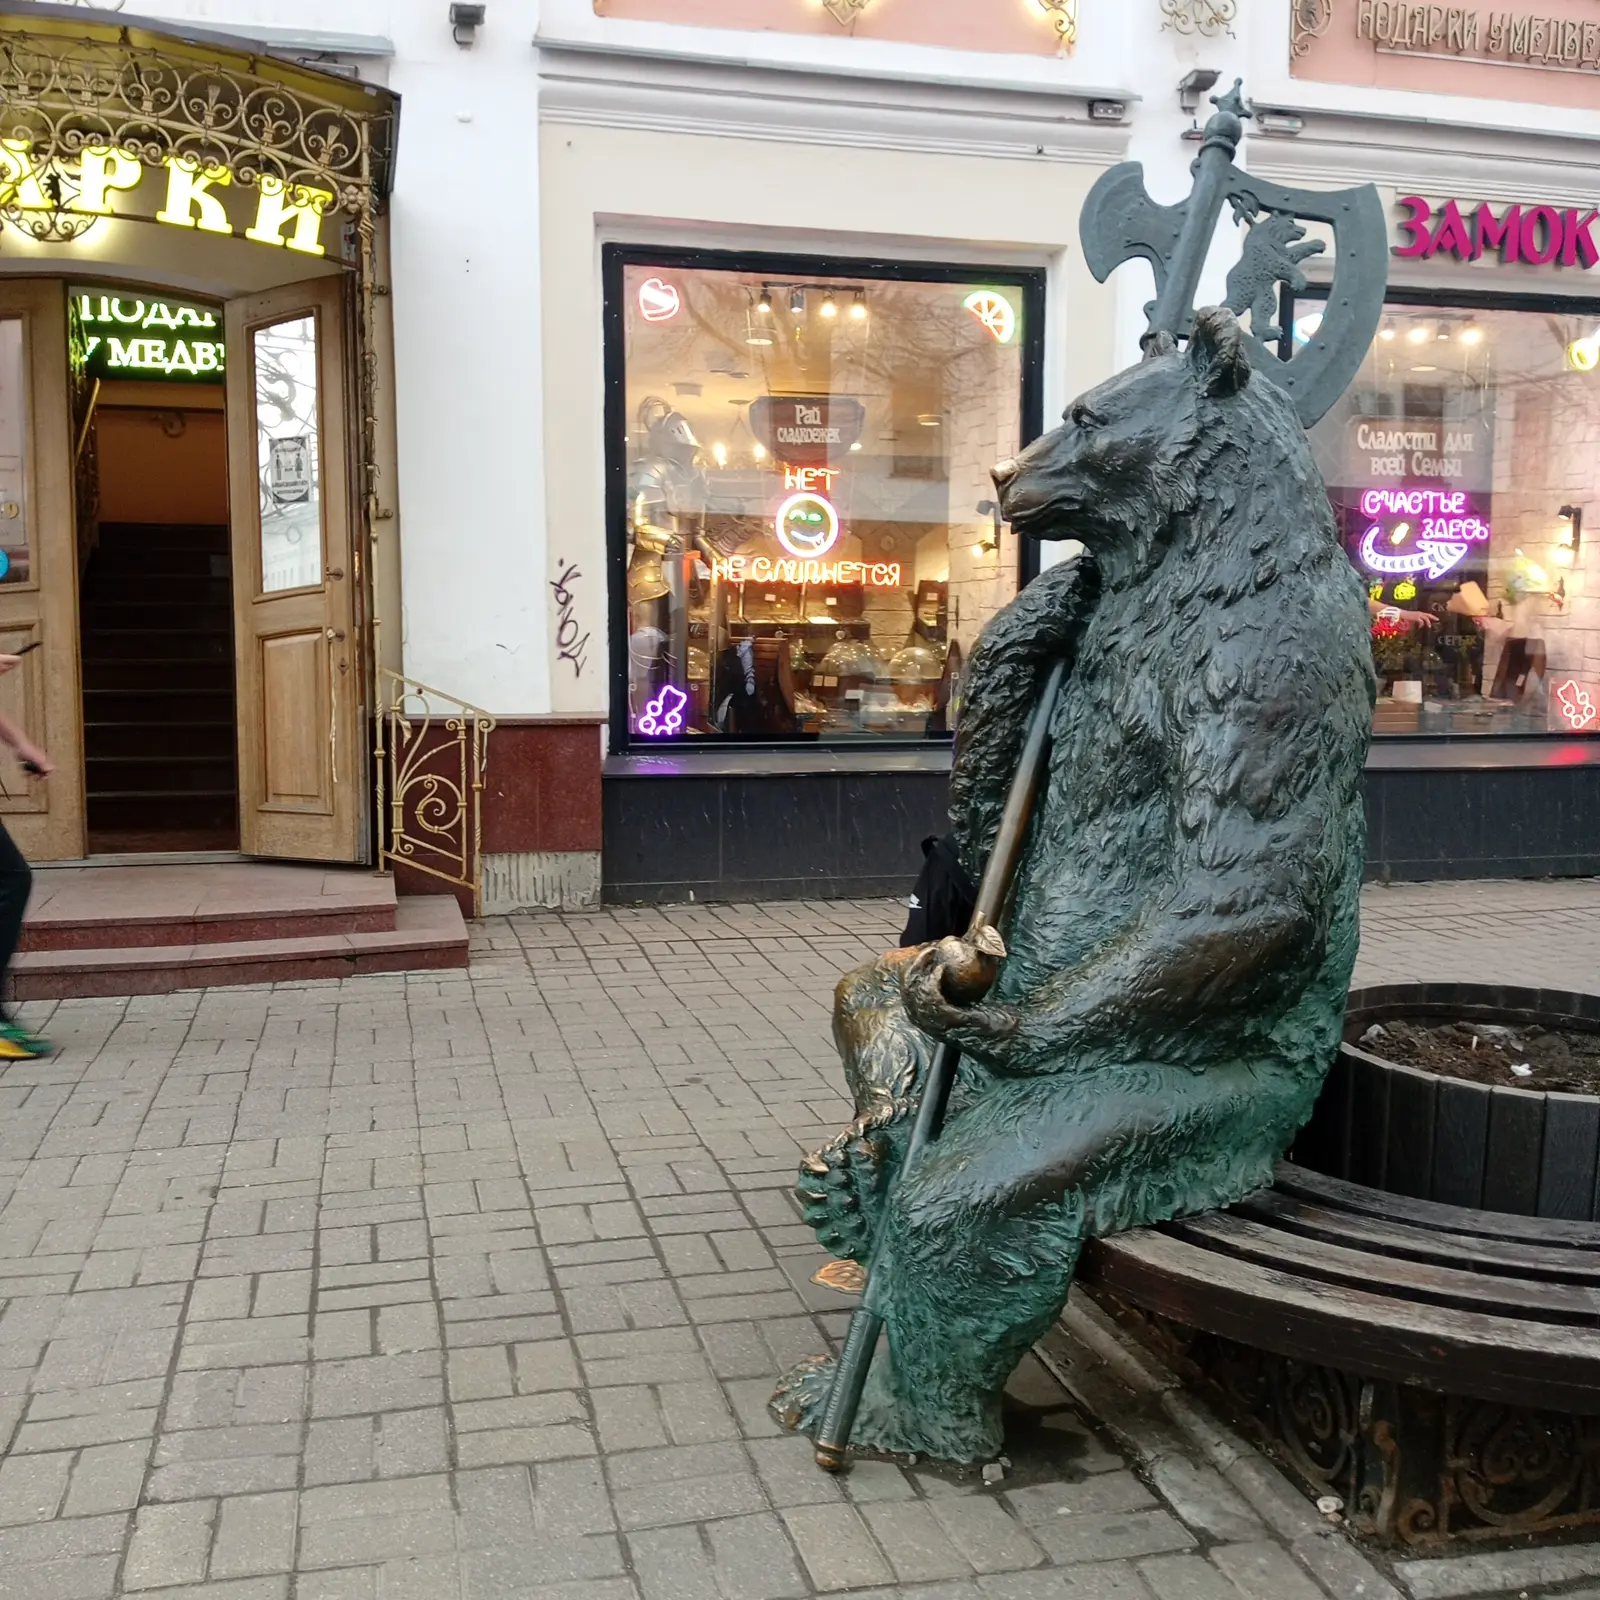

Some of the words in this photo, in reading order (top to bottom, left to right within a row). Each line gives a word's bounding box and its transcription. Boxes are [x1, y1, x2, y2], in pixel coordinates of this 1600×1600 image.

[1356, 0, 1480, 50] ПОДАРКИ
[1489, 12, 1505, 53] У
[1509, 13, 1600, 69] МЕДВЕ
[1391, 195, 1600, 269] ЗАМОК
[795, 404, 821, 425] Рай
[1357, 423, 1437, 452] Сладости
[1444, 432, 1475, 454] для
[1370, 453, 1406, 476] всей
[1412, 452, 1463, 477] Семьи
[784, 467, 840, 490] НЕТ
[1364, 490, 1466, 515] СЧАСТЬЕ
[1421, 517, 1490, 540] ЗДЕСЬ
[711, 556, 746, 582] НЕ
[752, 556, 900, 586] СЛИПНЕТСЯ
